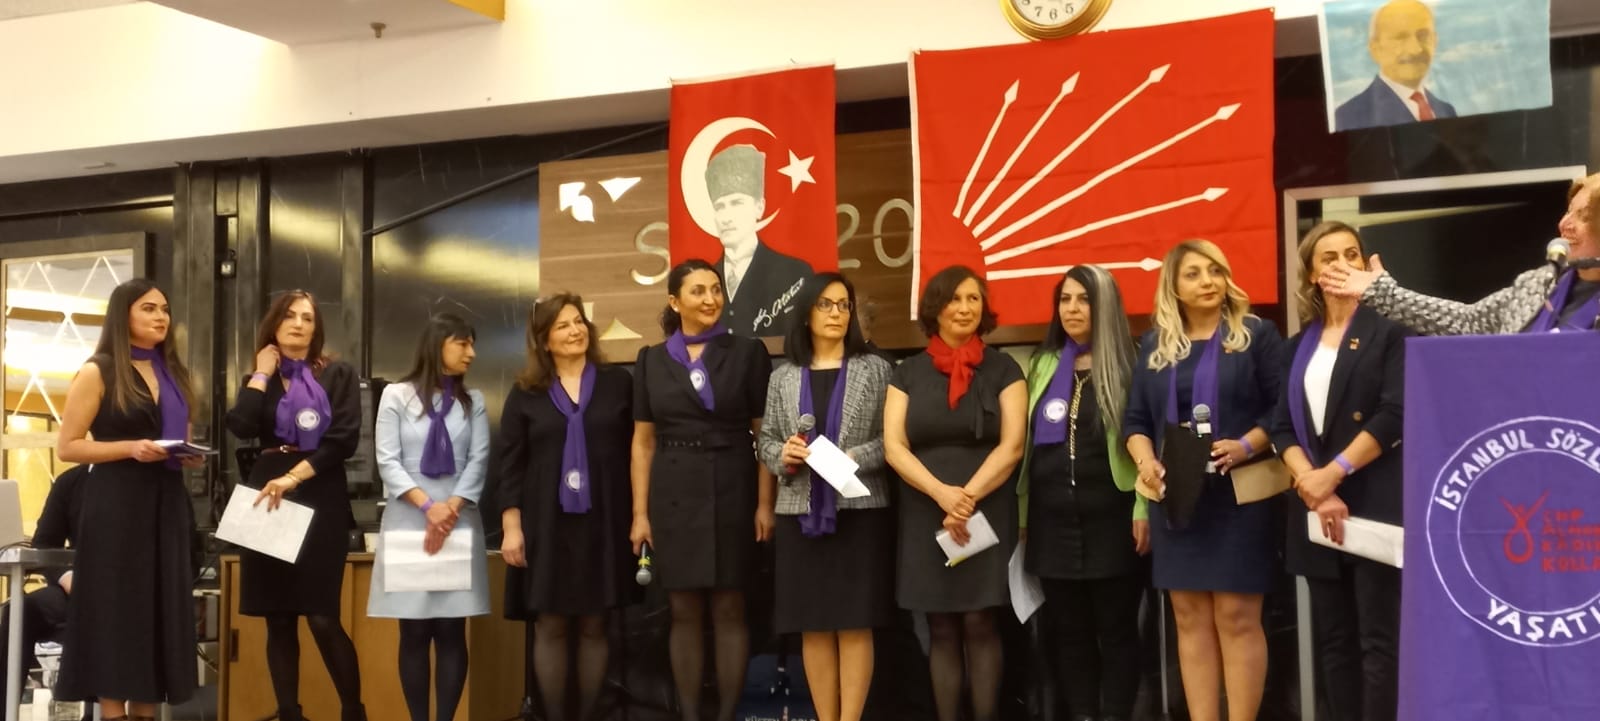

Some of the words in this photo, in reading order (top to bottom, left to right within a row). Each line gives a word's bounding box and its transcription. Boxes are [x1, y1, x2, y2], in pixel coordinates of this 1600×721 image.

[1034, 6, 1043, 17] 7
[1049, 9, 1058, 20] 6
[1434, 428, 1535, 511] İSTANBUL
